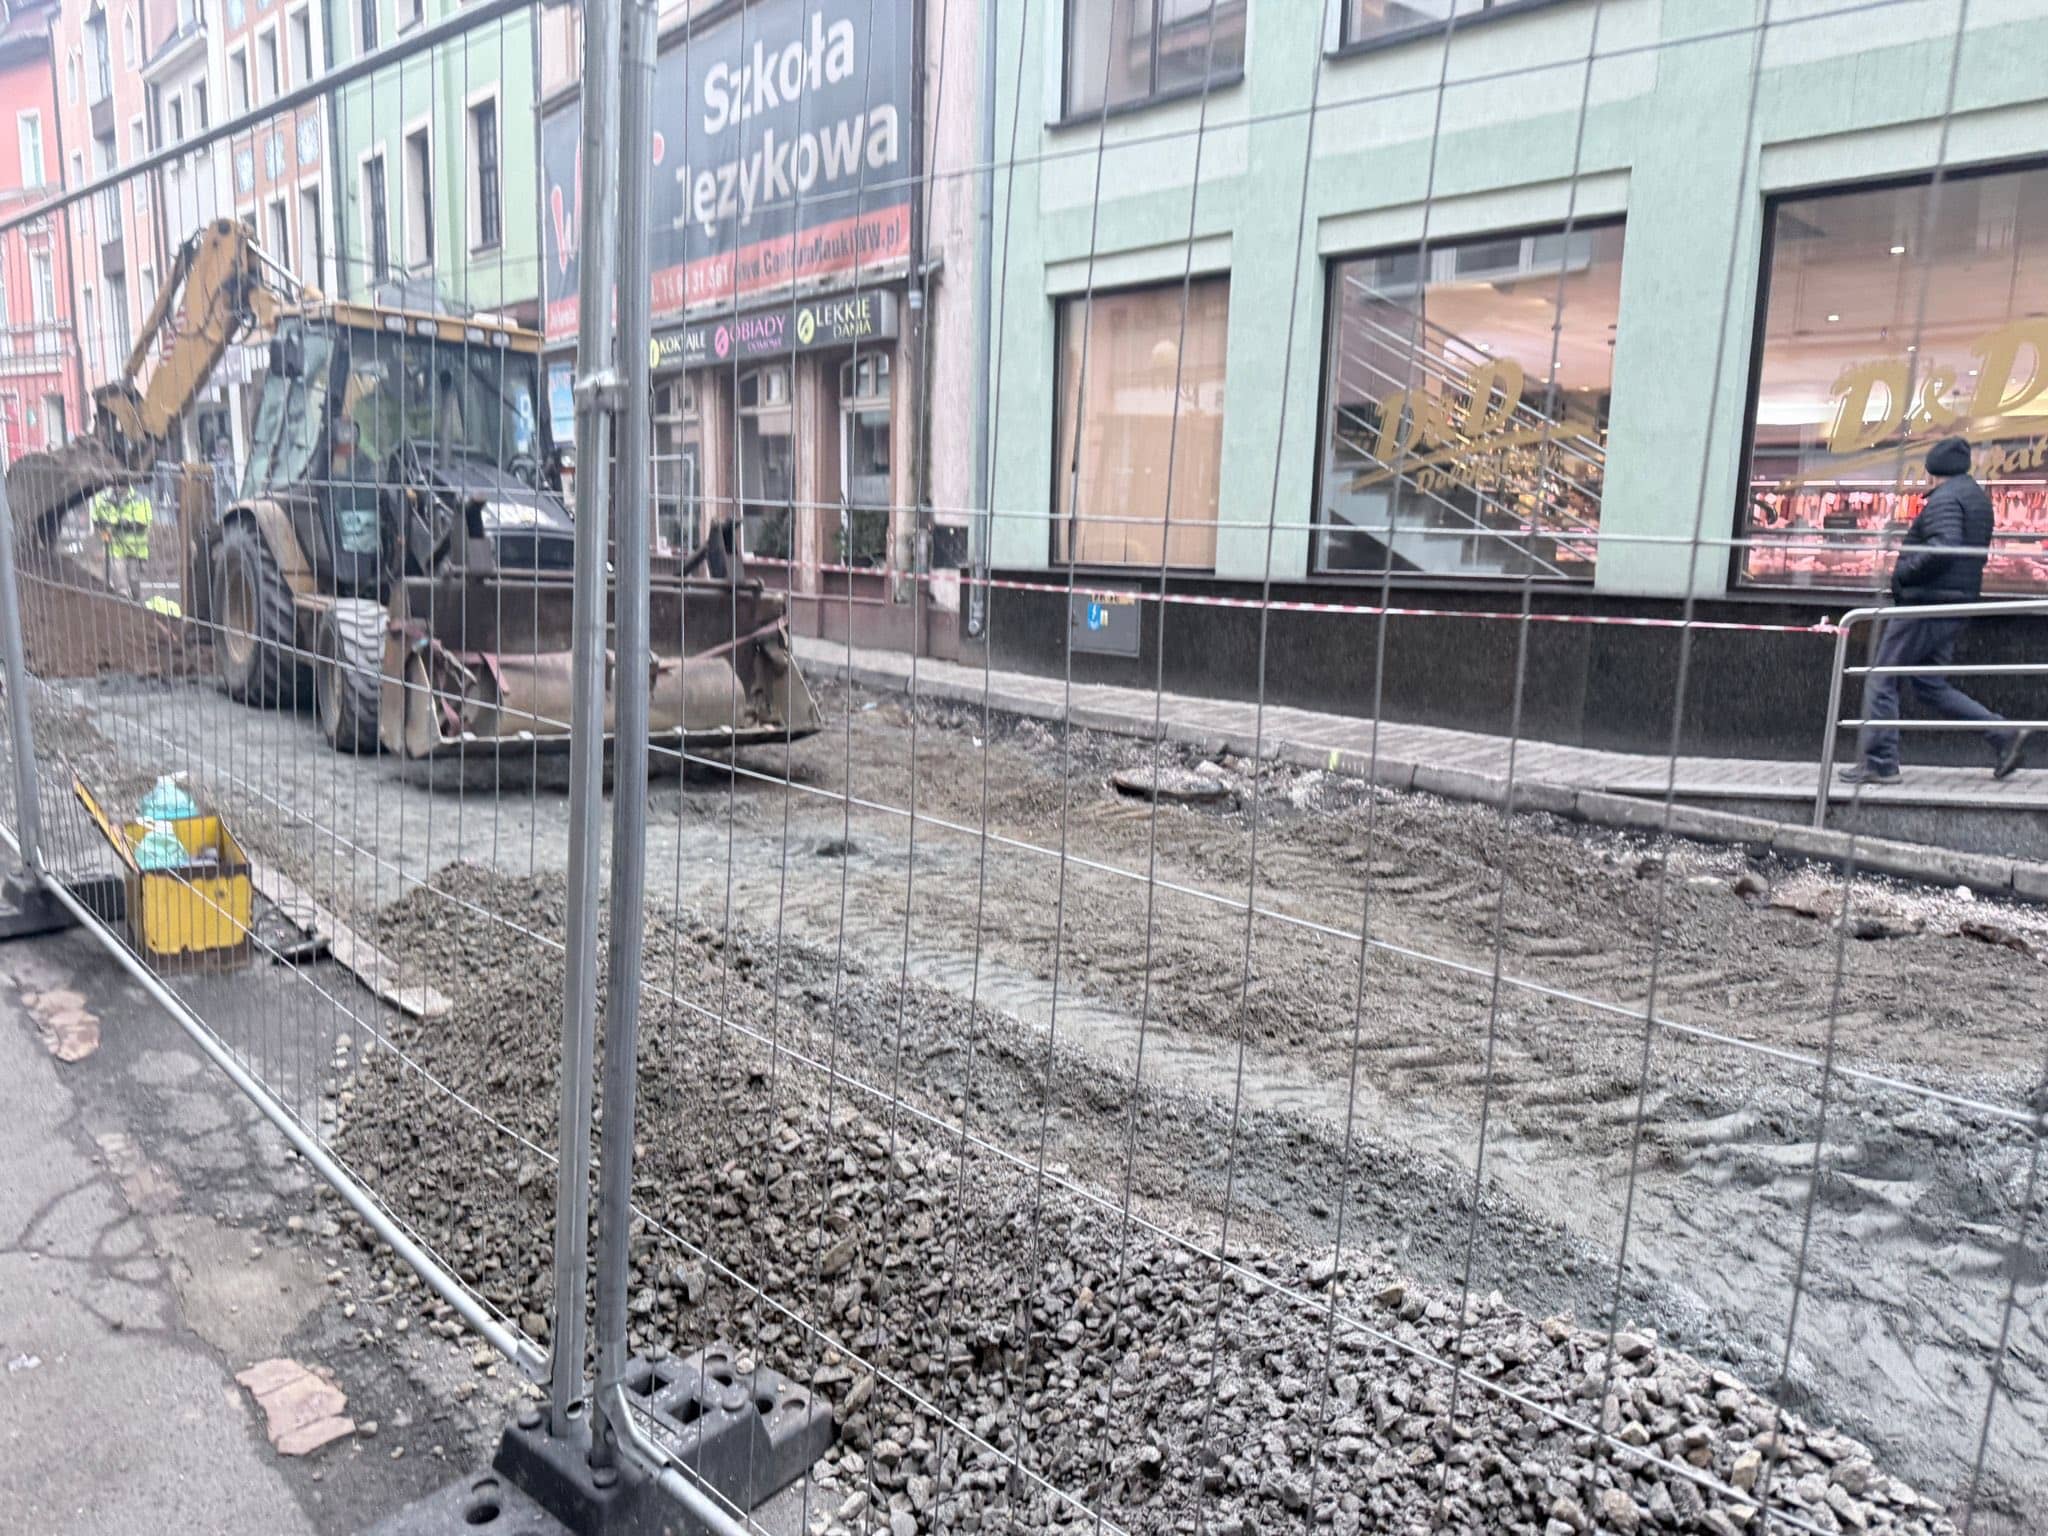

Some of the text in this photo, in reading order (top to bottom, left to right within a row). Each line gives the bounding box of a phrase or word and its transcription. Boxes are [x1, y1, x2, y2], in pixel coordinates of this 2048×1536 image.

[704, 11, 854, 135] Szkoła
[673, 103, 898, 237] Językowa
[730, 314, 785, 343] OBIADY
[816, 297, 871, 328] LEKKIE
[833, 319, 872, 339] DANIA
[1375, 357, 1524, 461] D&D
[1828, 320, 2048, 453] D&D
